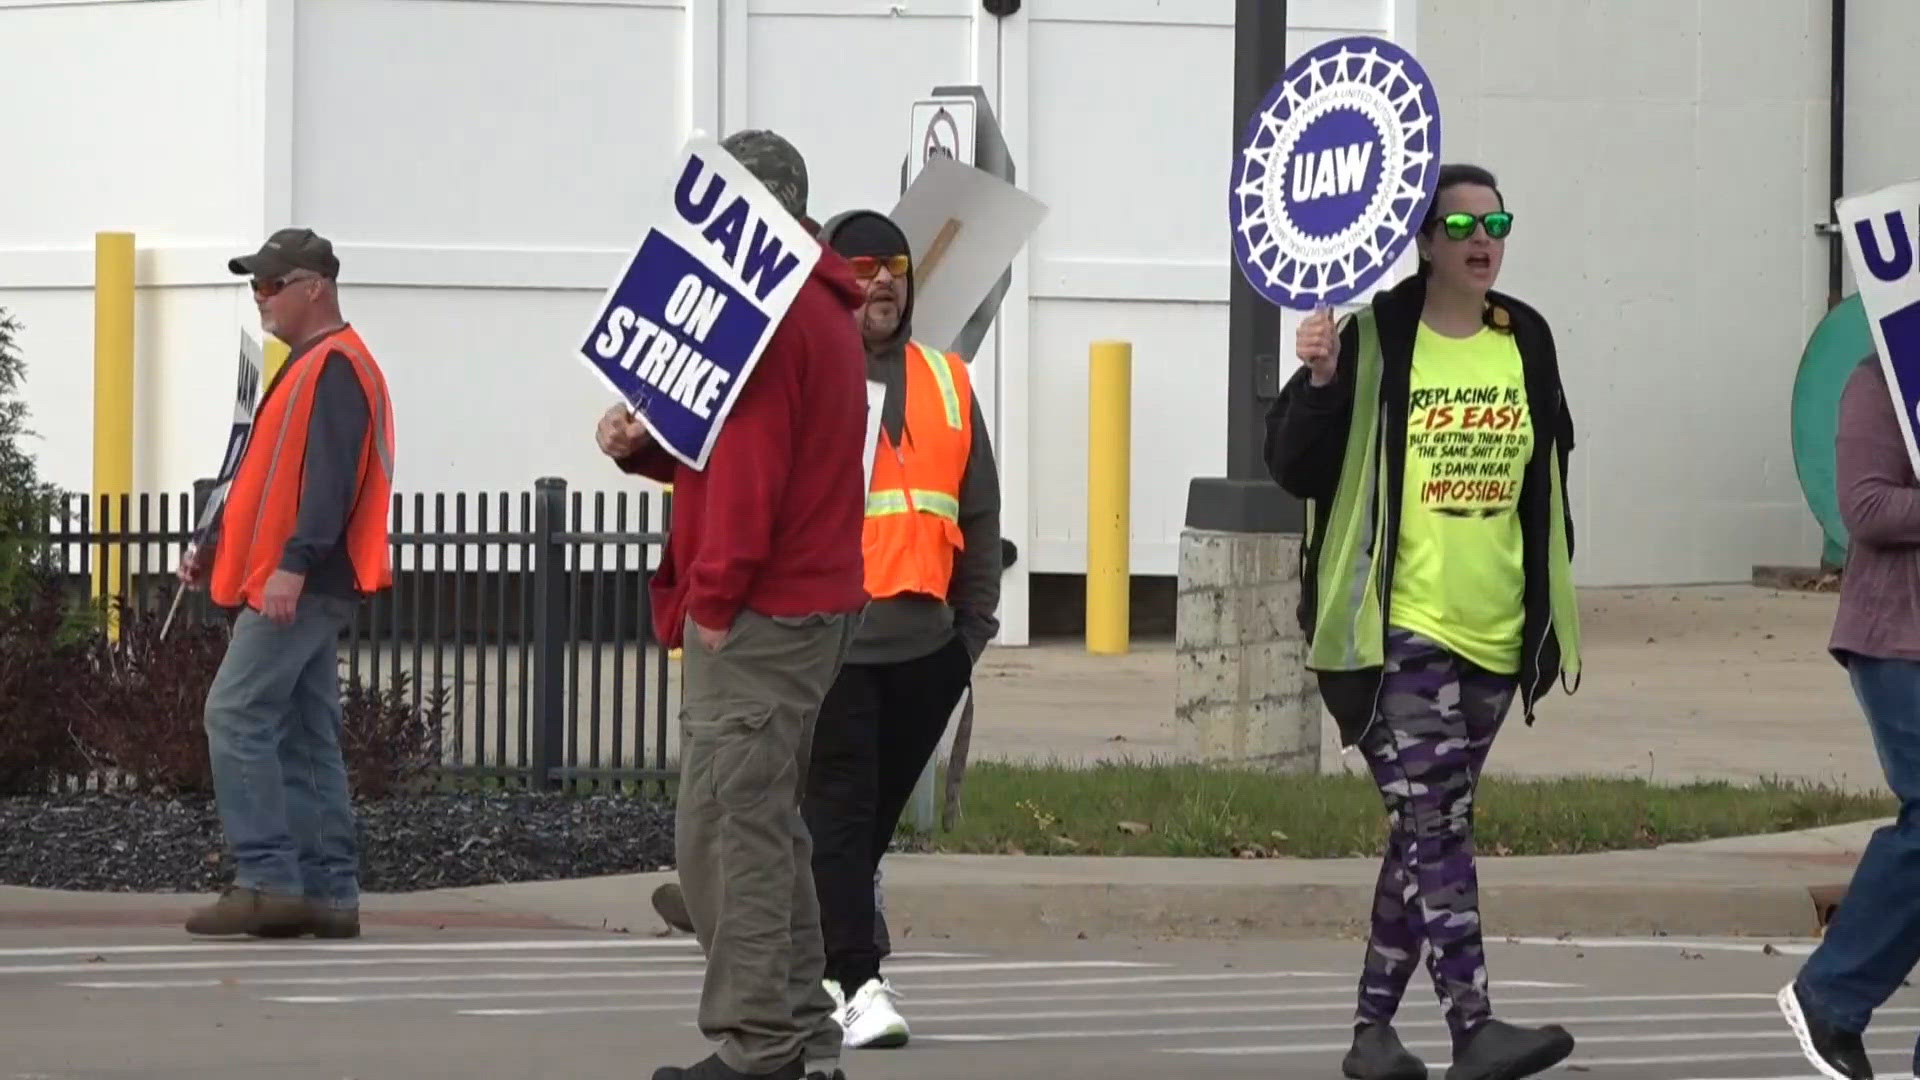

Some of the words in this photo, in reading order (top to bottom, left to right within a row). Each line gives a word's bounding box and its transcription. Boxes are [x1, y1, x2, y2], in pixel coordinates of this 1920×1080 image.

[1341, 86, 1373, 103] UNITED
[1292, 141, 1373, 202] UAW
[675, 153, 800, 303] UAW
[664, 273, 728, 343] ON
[595, 305, 731, 420] STRIKE
[1410, 386, 1499, 415] REPLACING
[1426, 406, 1454, 430] IS
[1462, 405, 1522, 431] EASY
[1410, 433, 1429, 447] BUT
[1433, 433, 1474, 444] GETTING
[1478, 432, 1503, 444] THEM
[1505, 434, 1517, 444] TO
[1519, 434, 1528, 446] DO
[1418, 446, 1438, 458] THE
[1440, 446, 1467, 458] SAME
[1470, 446, 1494, 458] SHIT
[1502, 446, 1520, 458] DID
[1431, 462, 1442, 477] IS
[1445, 461, 1478, 476] DAMN
[1479, 462, 1512, 477] NEAR
[1421, 480, 1517, 504] IMPOSSIBLE
